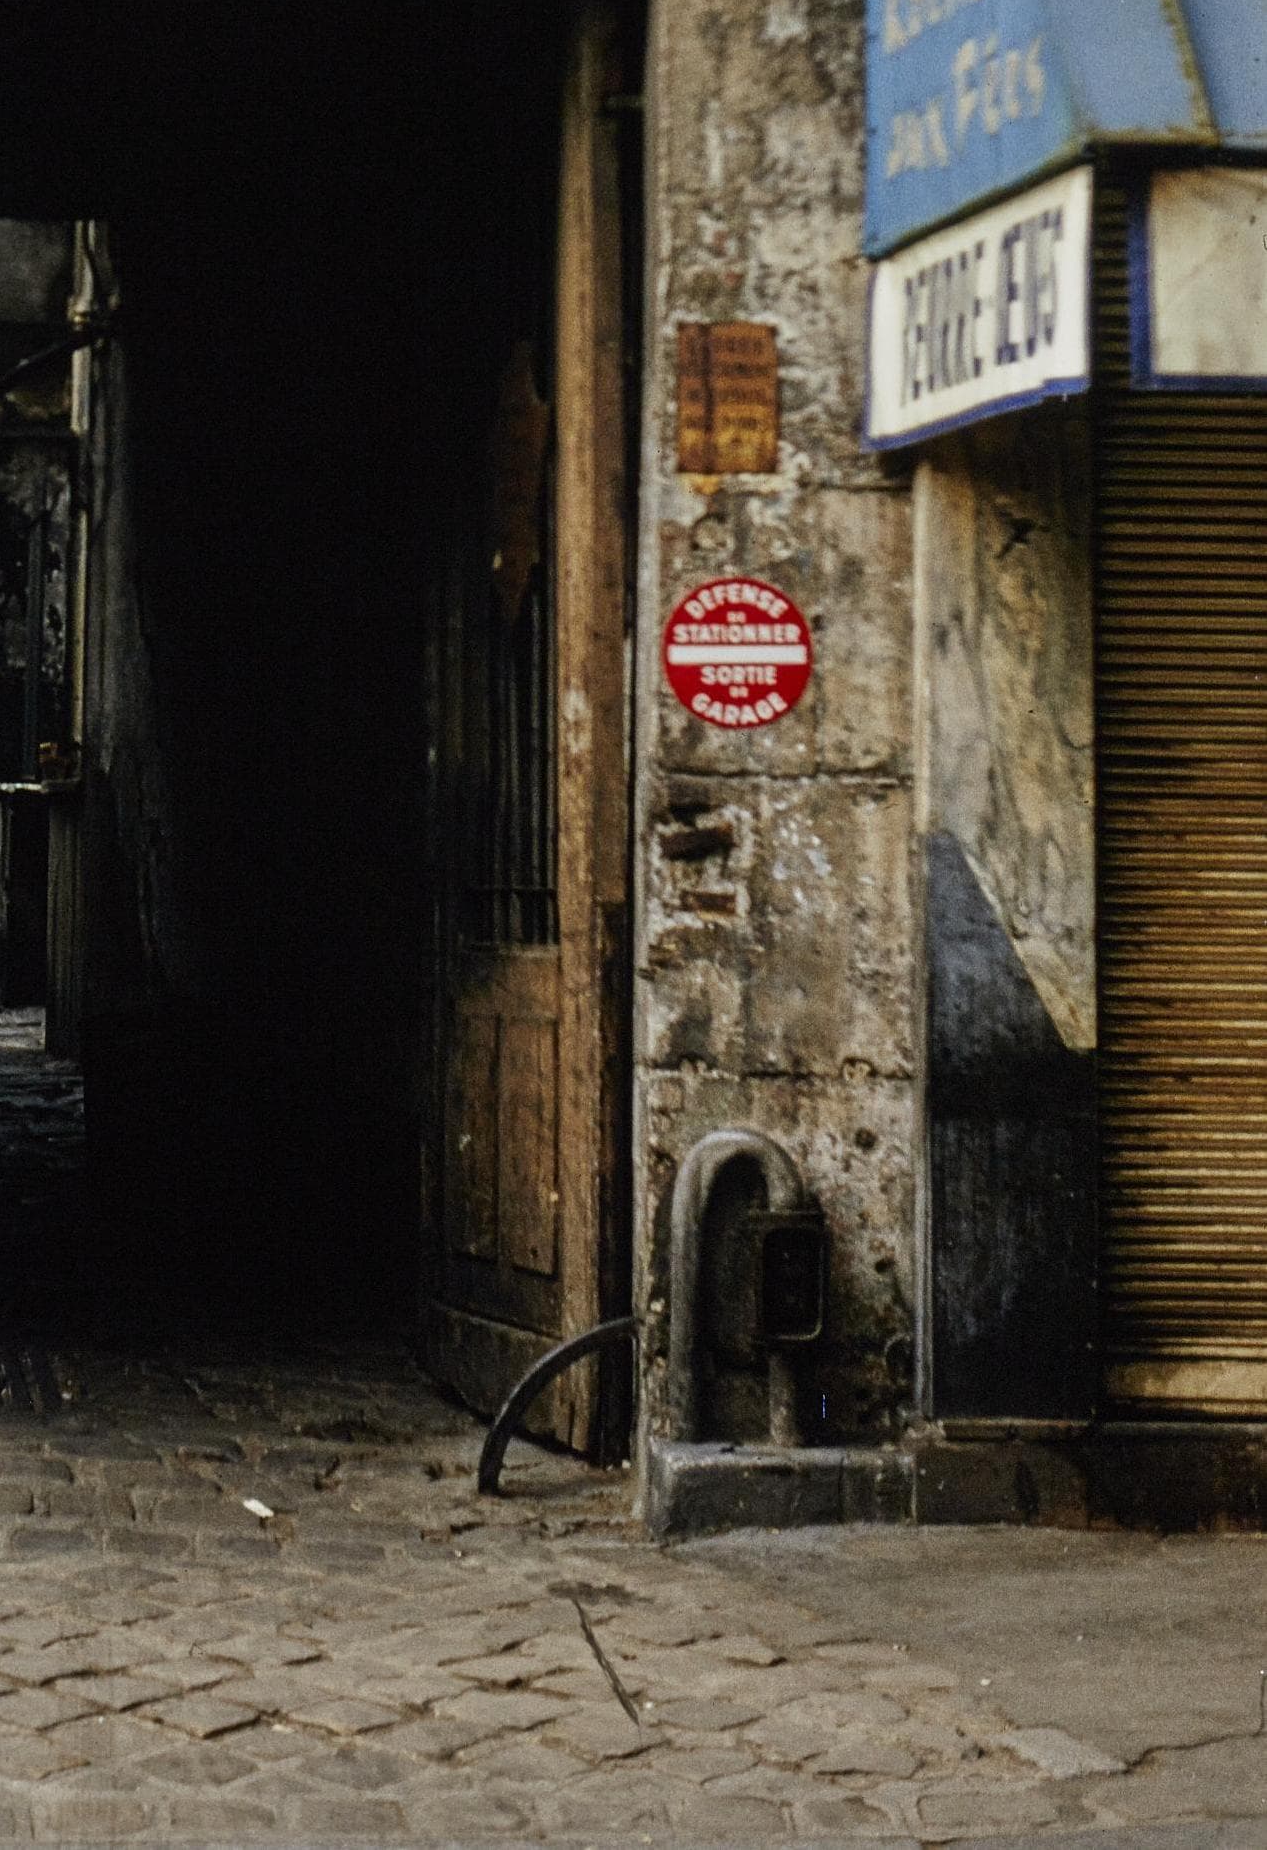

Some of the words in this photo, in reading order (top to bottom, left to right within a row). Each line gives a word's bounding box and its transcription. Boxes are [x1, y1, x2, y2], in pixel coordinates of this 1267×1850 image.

[673, 624, 801, 643] STATIONNER
[700, 665, 777, 685] SORTIE
[691, 691, 788, 725] GARAGE
